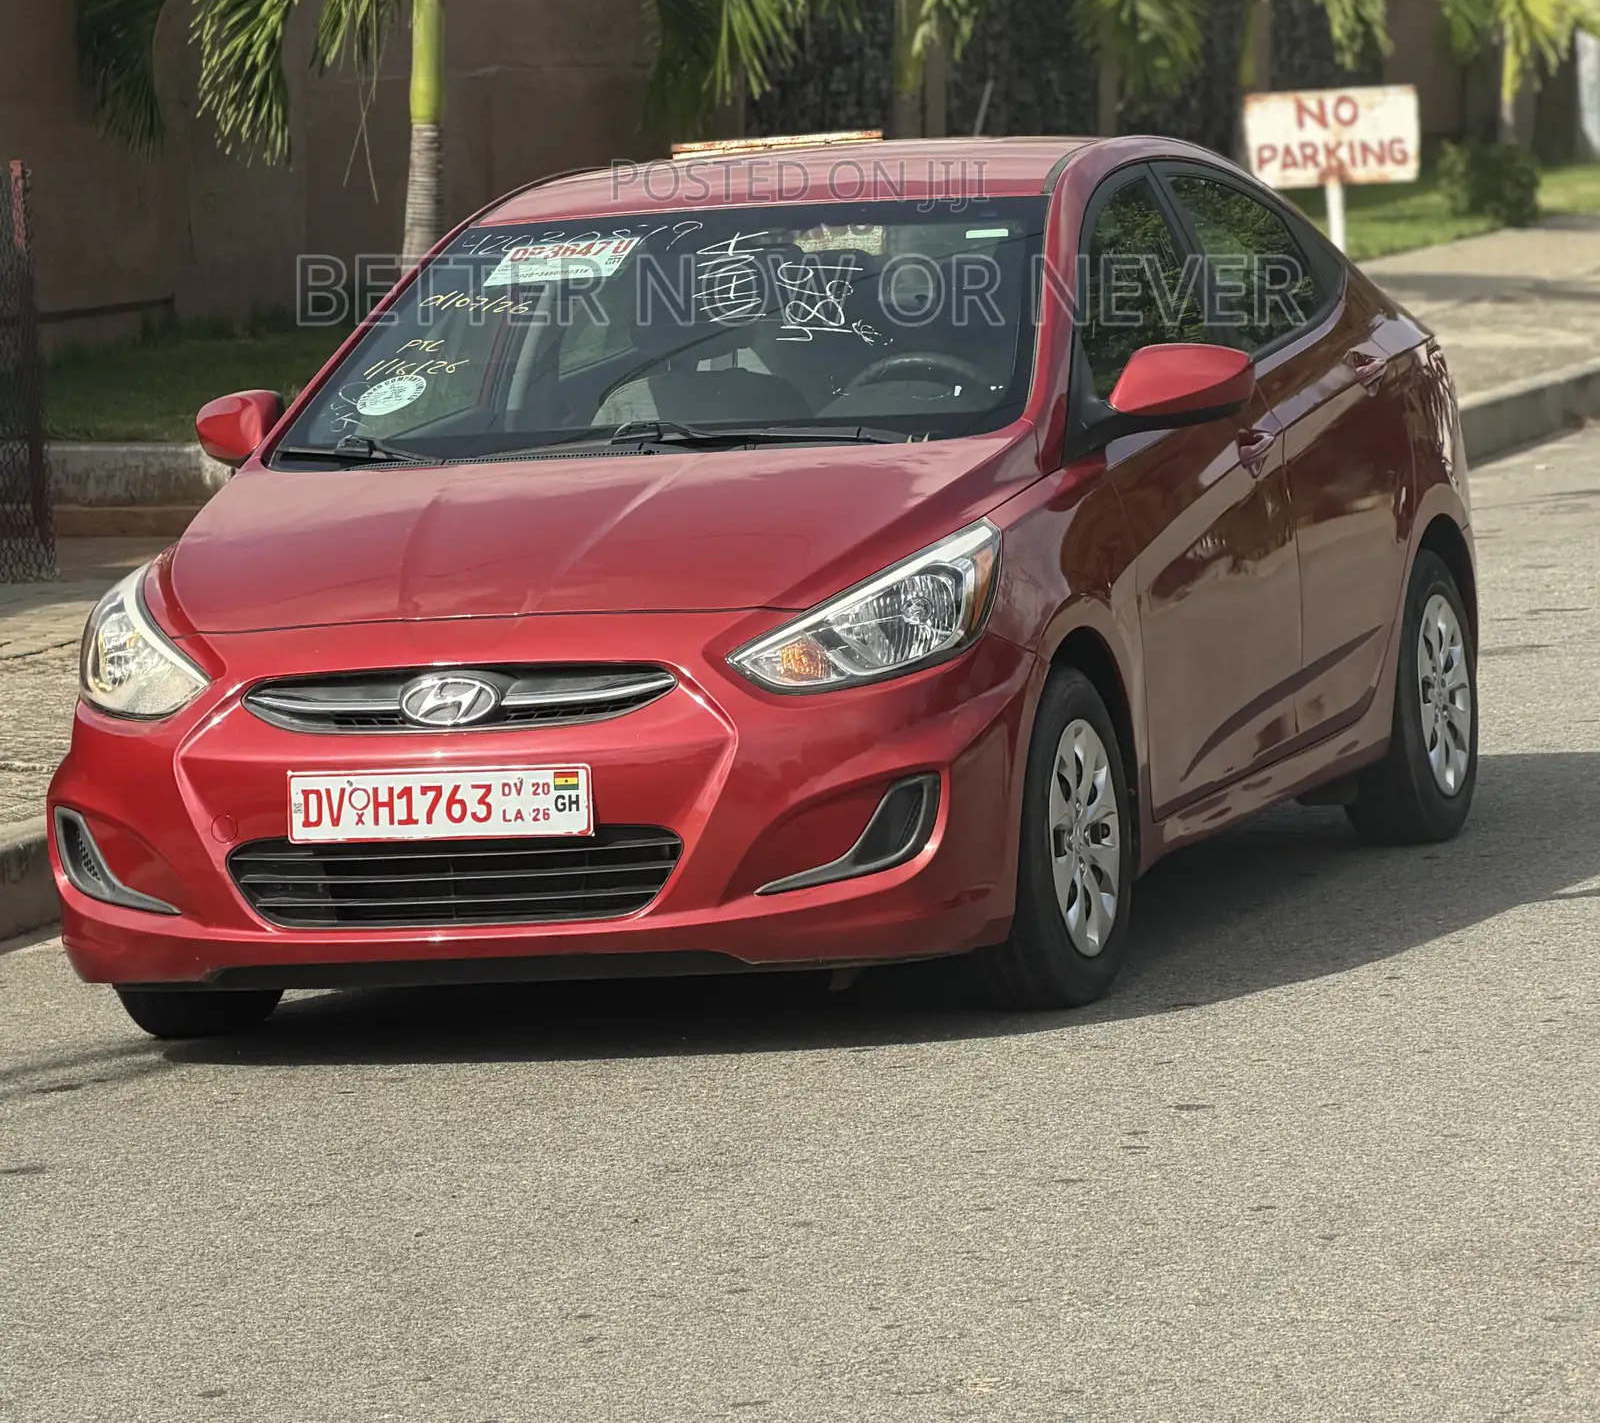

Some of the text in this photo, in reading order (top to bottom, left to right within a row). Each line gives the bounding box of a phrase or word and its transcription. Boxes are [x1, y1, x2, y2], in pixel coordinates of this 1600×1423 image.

[1295, 95, 1358, 129] NO
[1257, 138, 1409, 171] PARKING
[501, 781, 550, 797] DV 20
[301, 787, 345, 827] DV
[373, 783, 492, 827] H1763
[502, 807, 550, 823] LA 26
[554, 794, 580, 813] GH
